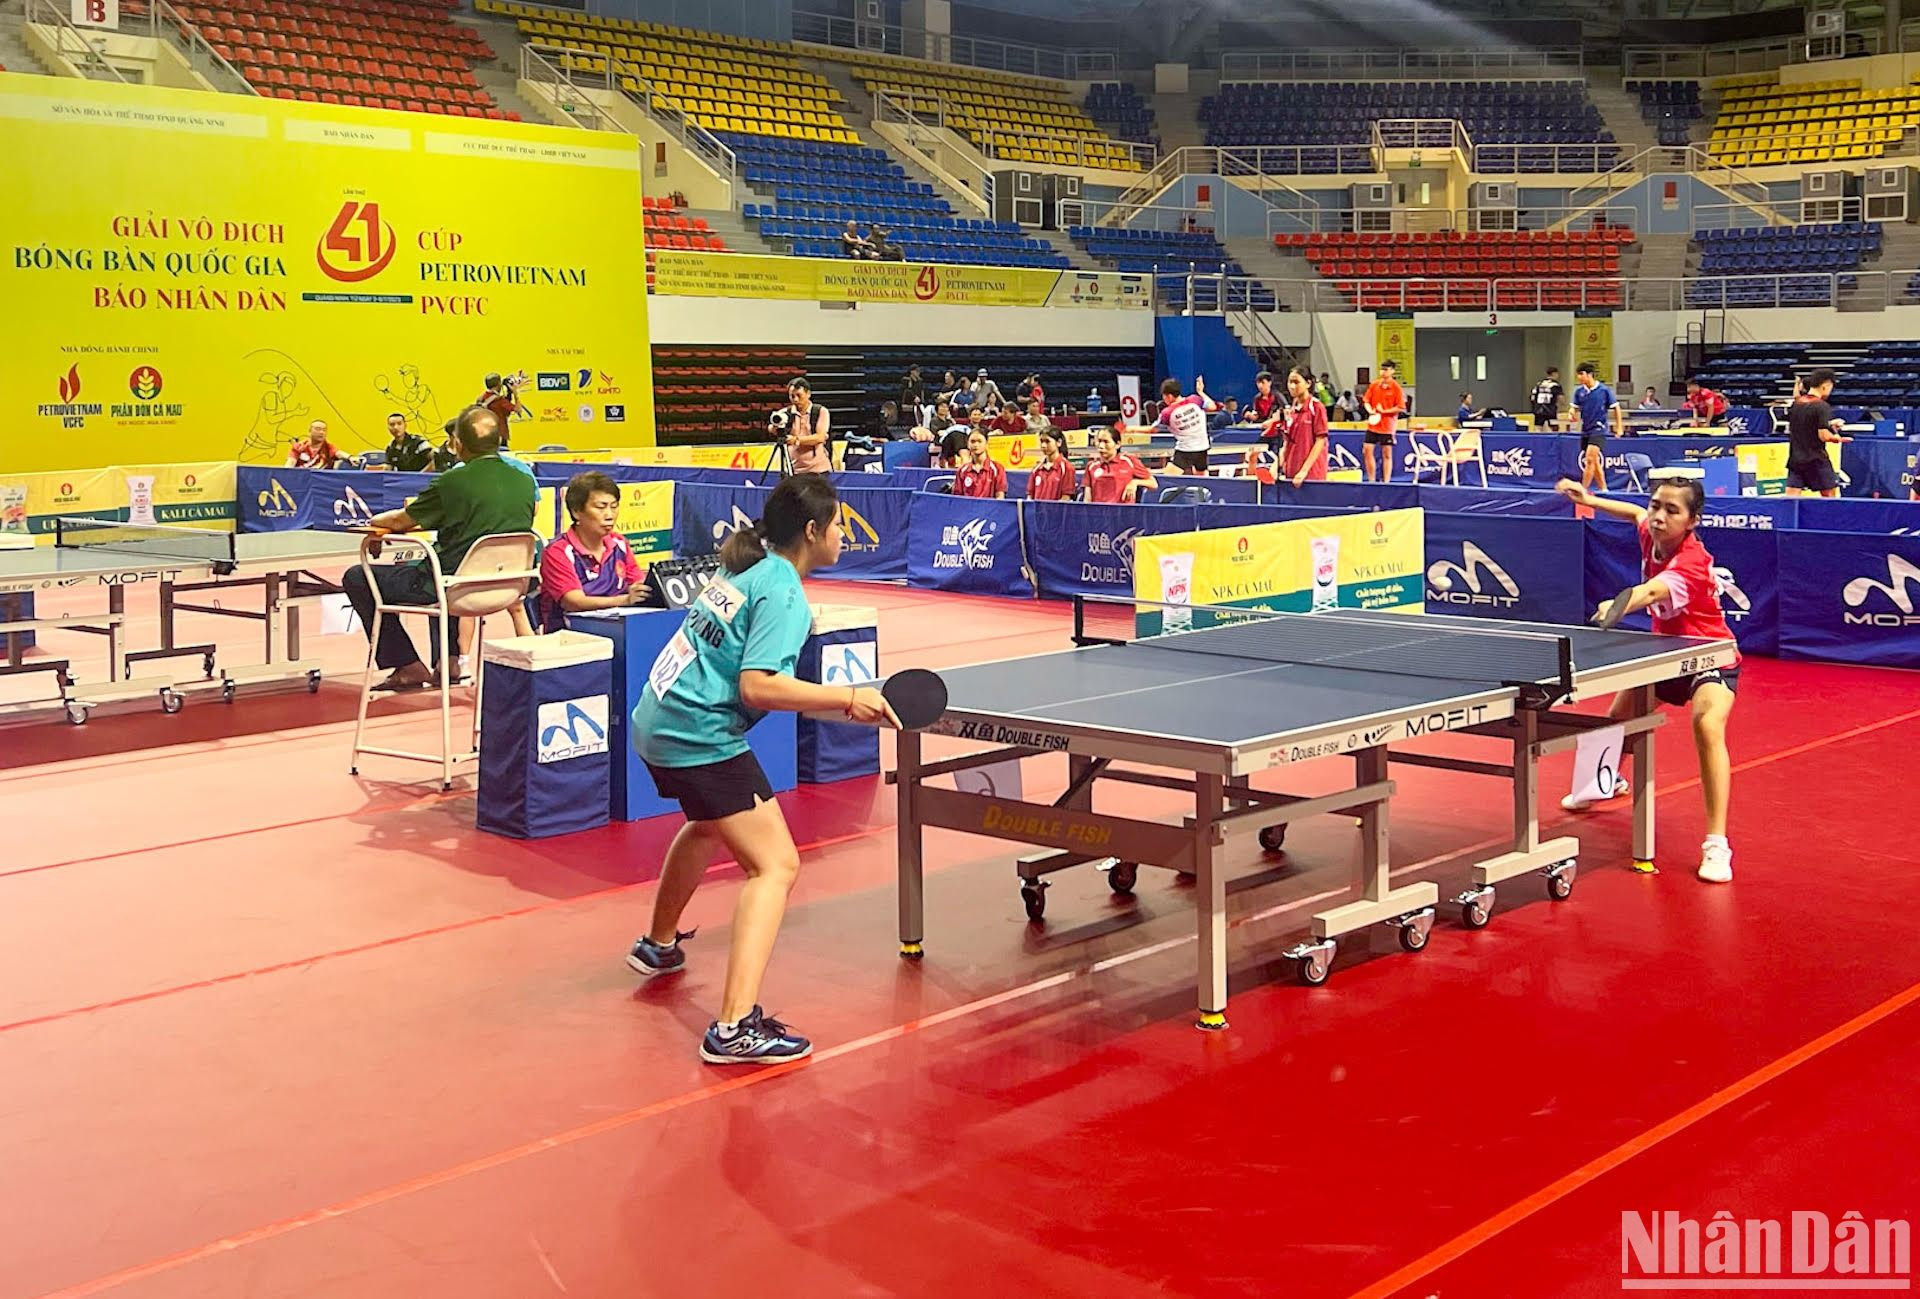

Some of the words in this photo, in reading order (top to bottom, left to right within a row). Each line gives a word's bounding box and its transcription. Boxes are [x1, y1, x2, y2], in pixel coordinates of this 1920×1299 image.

[112, 211, 168, 238] GIẢI
[178, 216, 214, 240] VÔ
[223, 221, 284, 245] ĐỊCH
[326, 202, 380, 261] 41
[418, 228, 462, 251] CÚP
[15, 244, 92, 271] BÓNG
[104, 246, 156, 272] BÀN
[165, 248, 237, 276] QUỐC
[245, 256, 287, 276] GIA
[419, 262, 586, 286] PETROVIETNAM
[825, 275, 849, 286] BÓNG
[870, 276, 890, 287] QUỐC
[894, 279, 908, 288] GIA
[917, 266, 935, 292] 41
[946, 280, 1005, 291] PETROVIETNAM
[95, 283, 147, 309] BÁO
[156, 286, 228, 310] NHÂN
[237, 287, 287, 311] DÂN
[421, 296, 489, 316] PVCFC
[1489, 313, 1497, 325] 3
[81, 344, 105, 353] ĐỒNG
[540, 377, 560, 388] BIDV
[38, 404, 102, 416] PETROVIETNAM
[111, 402, 134, 417] PHÂN
[166, 404, 182, 416] MAU
[63, 417, 84, 428] VCFC
[161, 507, 187, 519] KALI
[204, 506, 228, 518] MAU
[259, 509, 298, 517] MOFIT
[840, 543, 879, 552] OFIT
[933, 551, 964, 568] DOUBLE
[973, 554, 994, 569] FISH
[99, 571, 182, 586] MOFIT
[1081, 563, 1128, 584] DOUBLE
[1354, 566, 1372, 578] NPK
[1387, 561, 1404, 574] MAU
[666, 578, 689, 605] 0
[1168, 583, 1187, 597] NPK
[1212, 582, 1233, 598] NPK
[1252, 580, 1273, 593] MAU
[1426, 589, 1519, 608] MOFIT
[1701, 655, 1715, 669] 235
[1405, 705, 1488, 739] MOFIT
[959, 720, 995, 742] 双鱼
[996, 726, 1041, 748] DOUBLE
[1043, 735, 1070, 750] FISH
[540, 741, 604, 762] MOFIT
[1291, 745, 1322, 762] DOUBLE
[1323, 741, 1339, 754] FISH
[1596, 746, 1613, 796] 6
[983, 805, 1061, 837] DOUBLE
[1066, 823, 1112, 845] FISH
